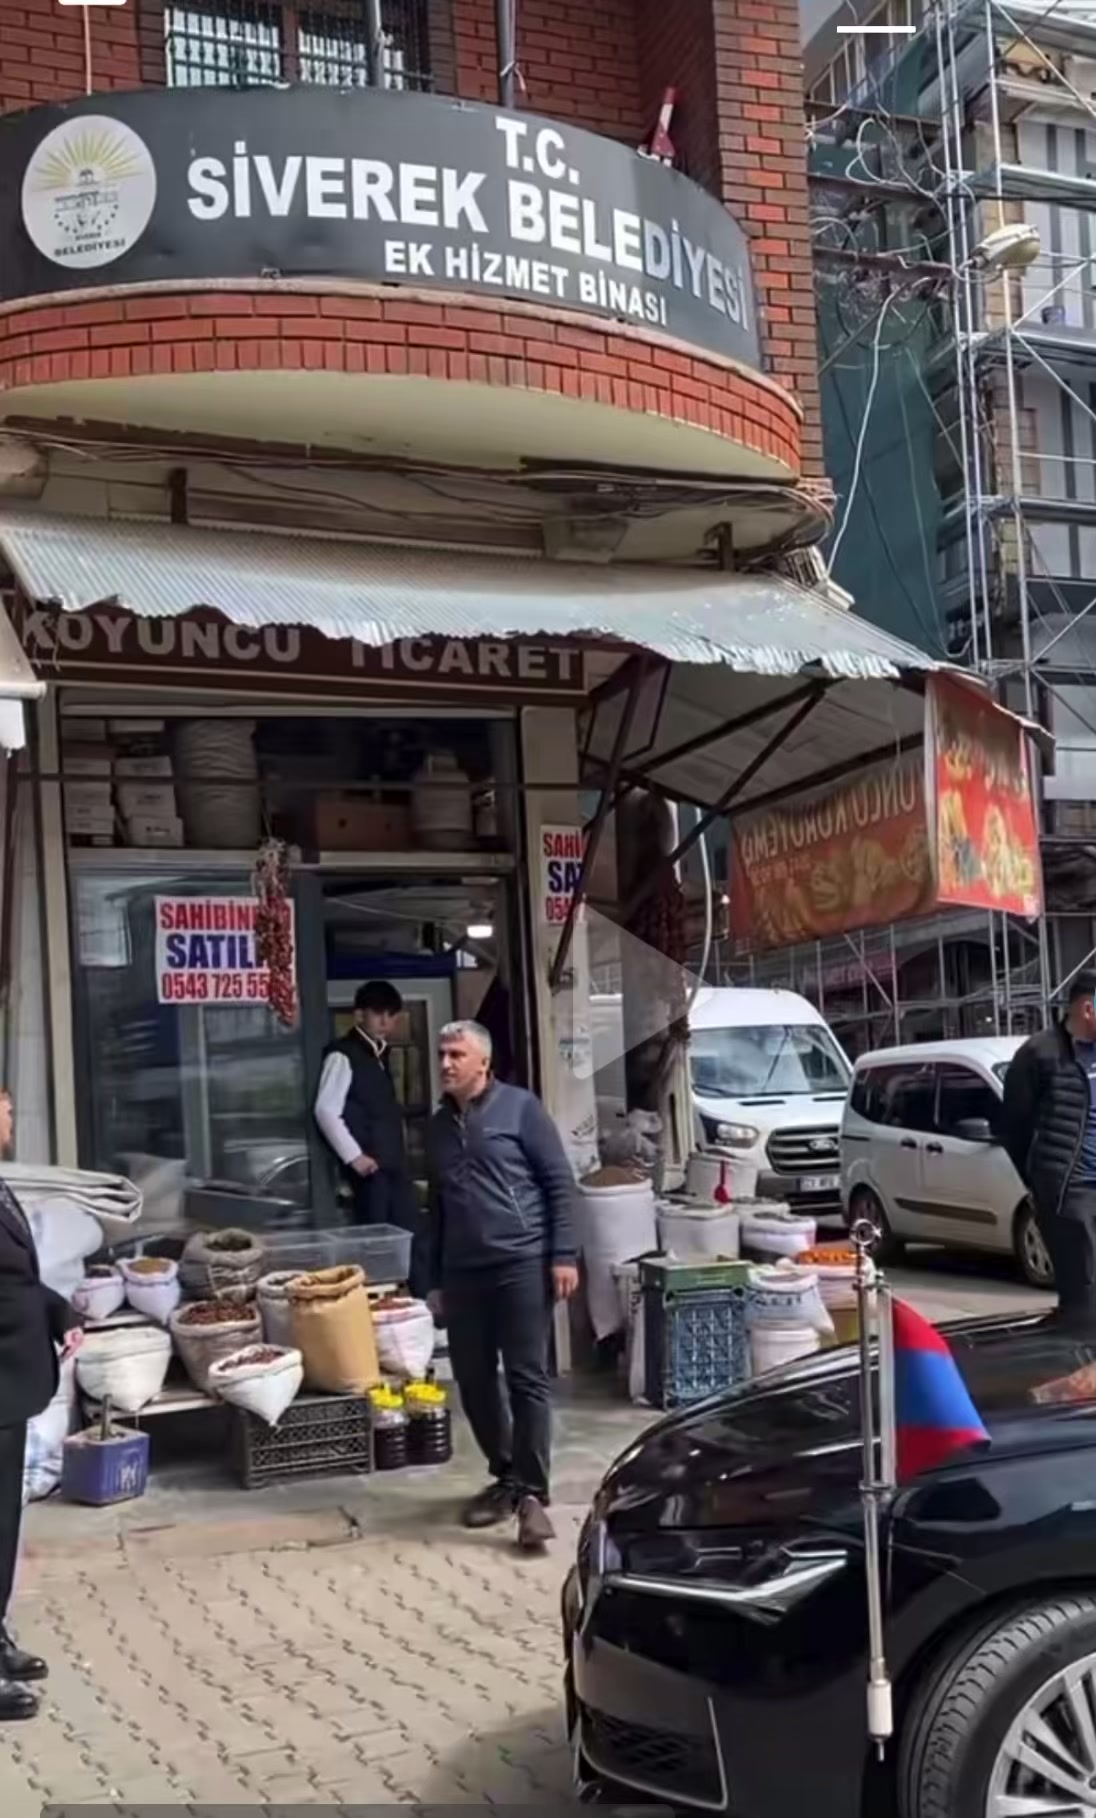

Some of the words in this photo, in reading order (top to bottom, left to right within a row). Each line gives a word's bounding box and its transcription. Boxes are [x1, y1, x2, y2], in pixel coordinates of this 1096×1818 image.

[495, 115, 580, 185] T.C.
[187, 141, 489, 233] SİVEREK
[508, 179, 749, 331] BELEDİYESİ
[384, 240, 435, 276] EK
[445, 242, 568, 298] HİZMET
[579, 269, 668, 327] BİNASI
[23, 609, 300, 663] KOYUNCU
[543, 829, 586, 859] SAHİ
[160, 899, 264, 931] SAHİBİN
[162, 972, 208, 999] 0543
[212, 972, 242, 998] 725
